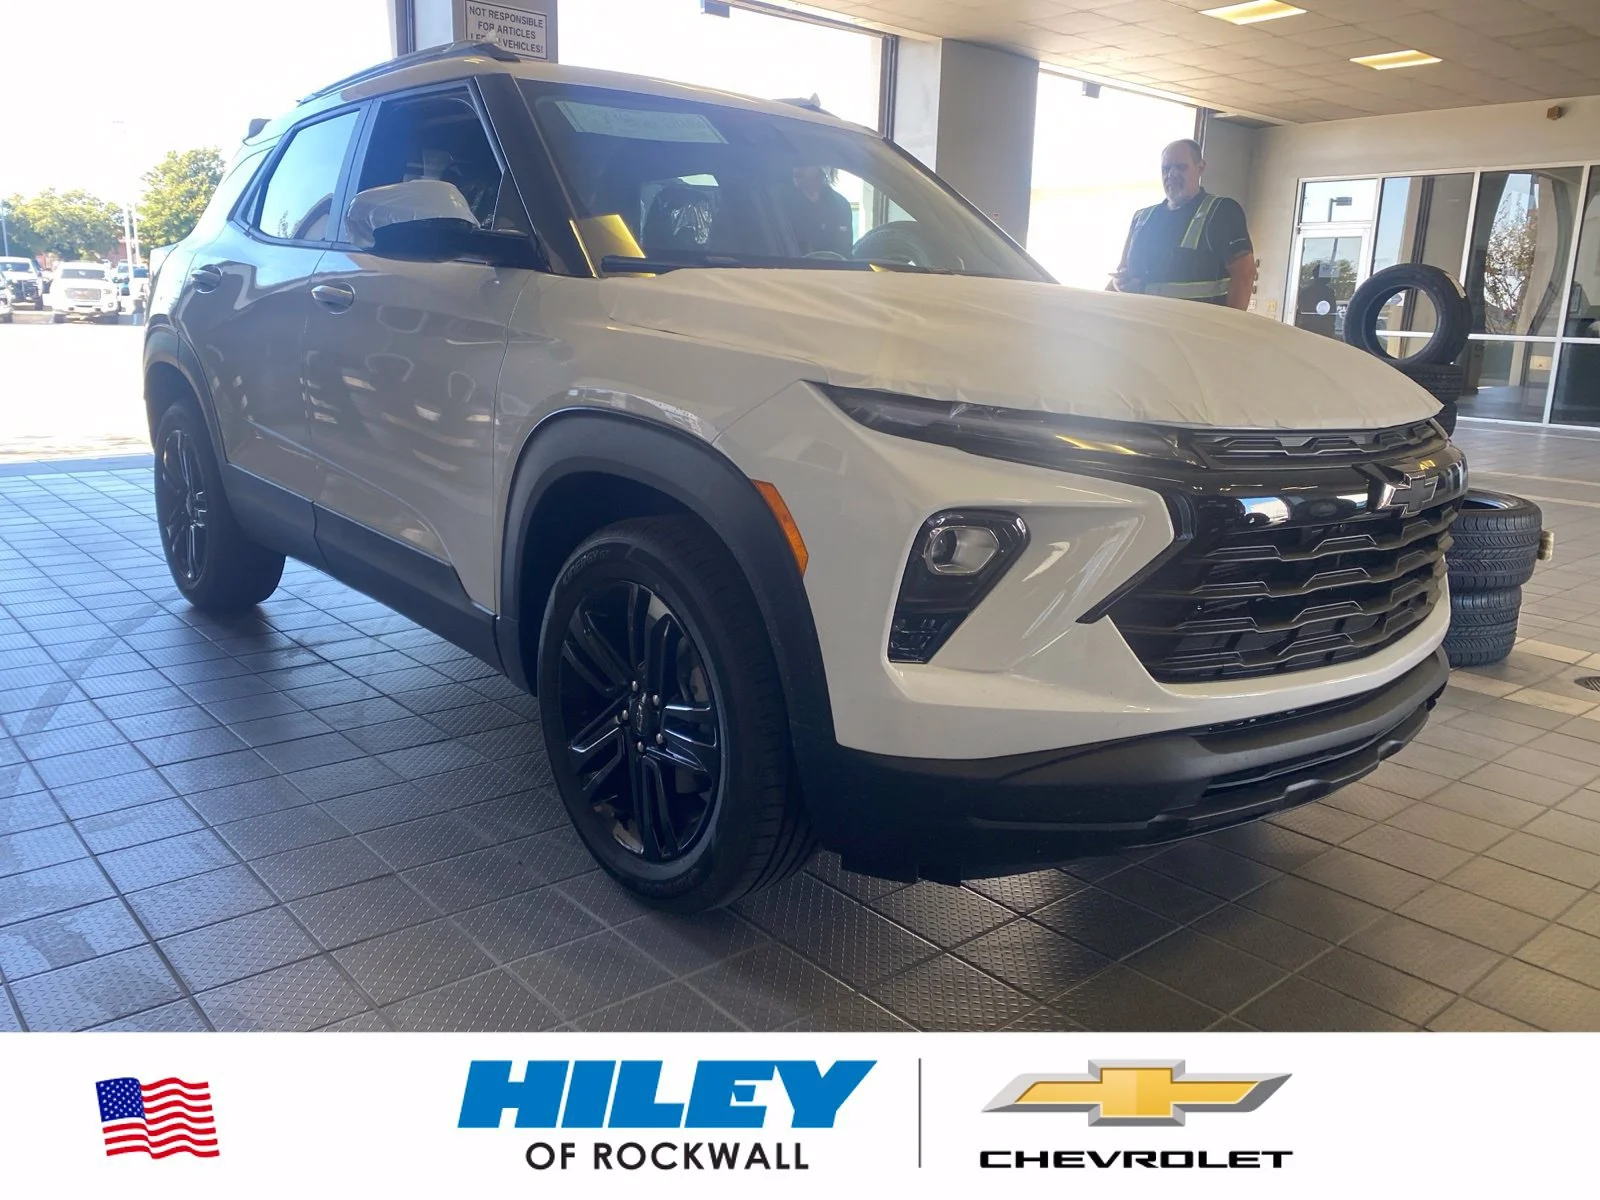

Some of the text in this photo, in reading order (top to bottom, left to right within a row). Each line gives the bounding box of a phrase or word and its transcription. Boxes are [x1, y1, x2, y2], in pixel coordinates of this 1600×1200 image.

[469, 6, 544, 29] NOT RESPONSIBLE
[478, 21, 536, 40] FOR ARTICLES
[503, 39, 544, 54] VEHICLES!
